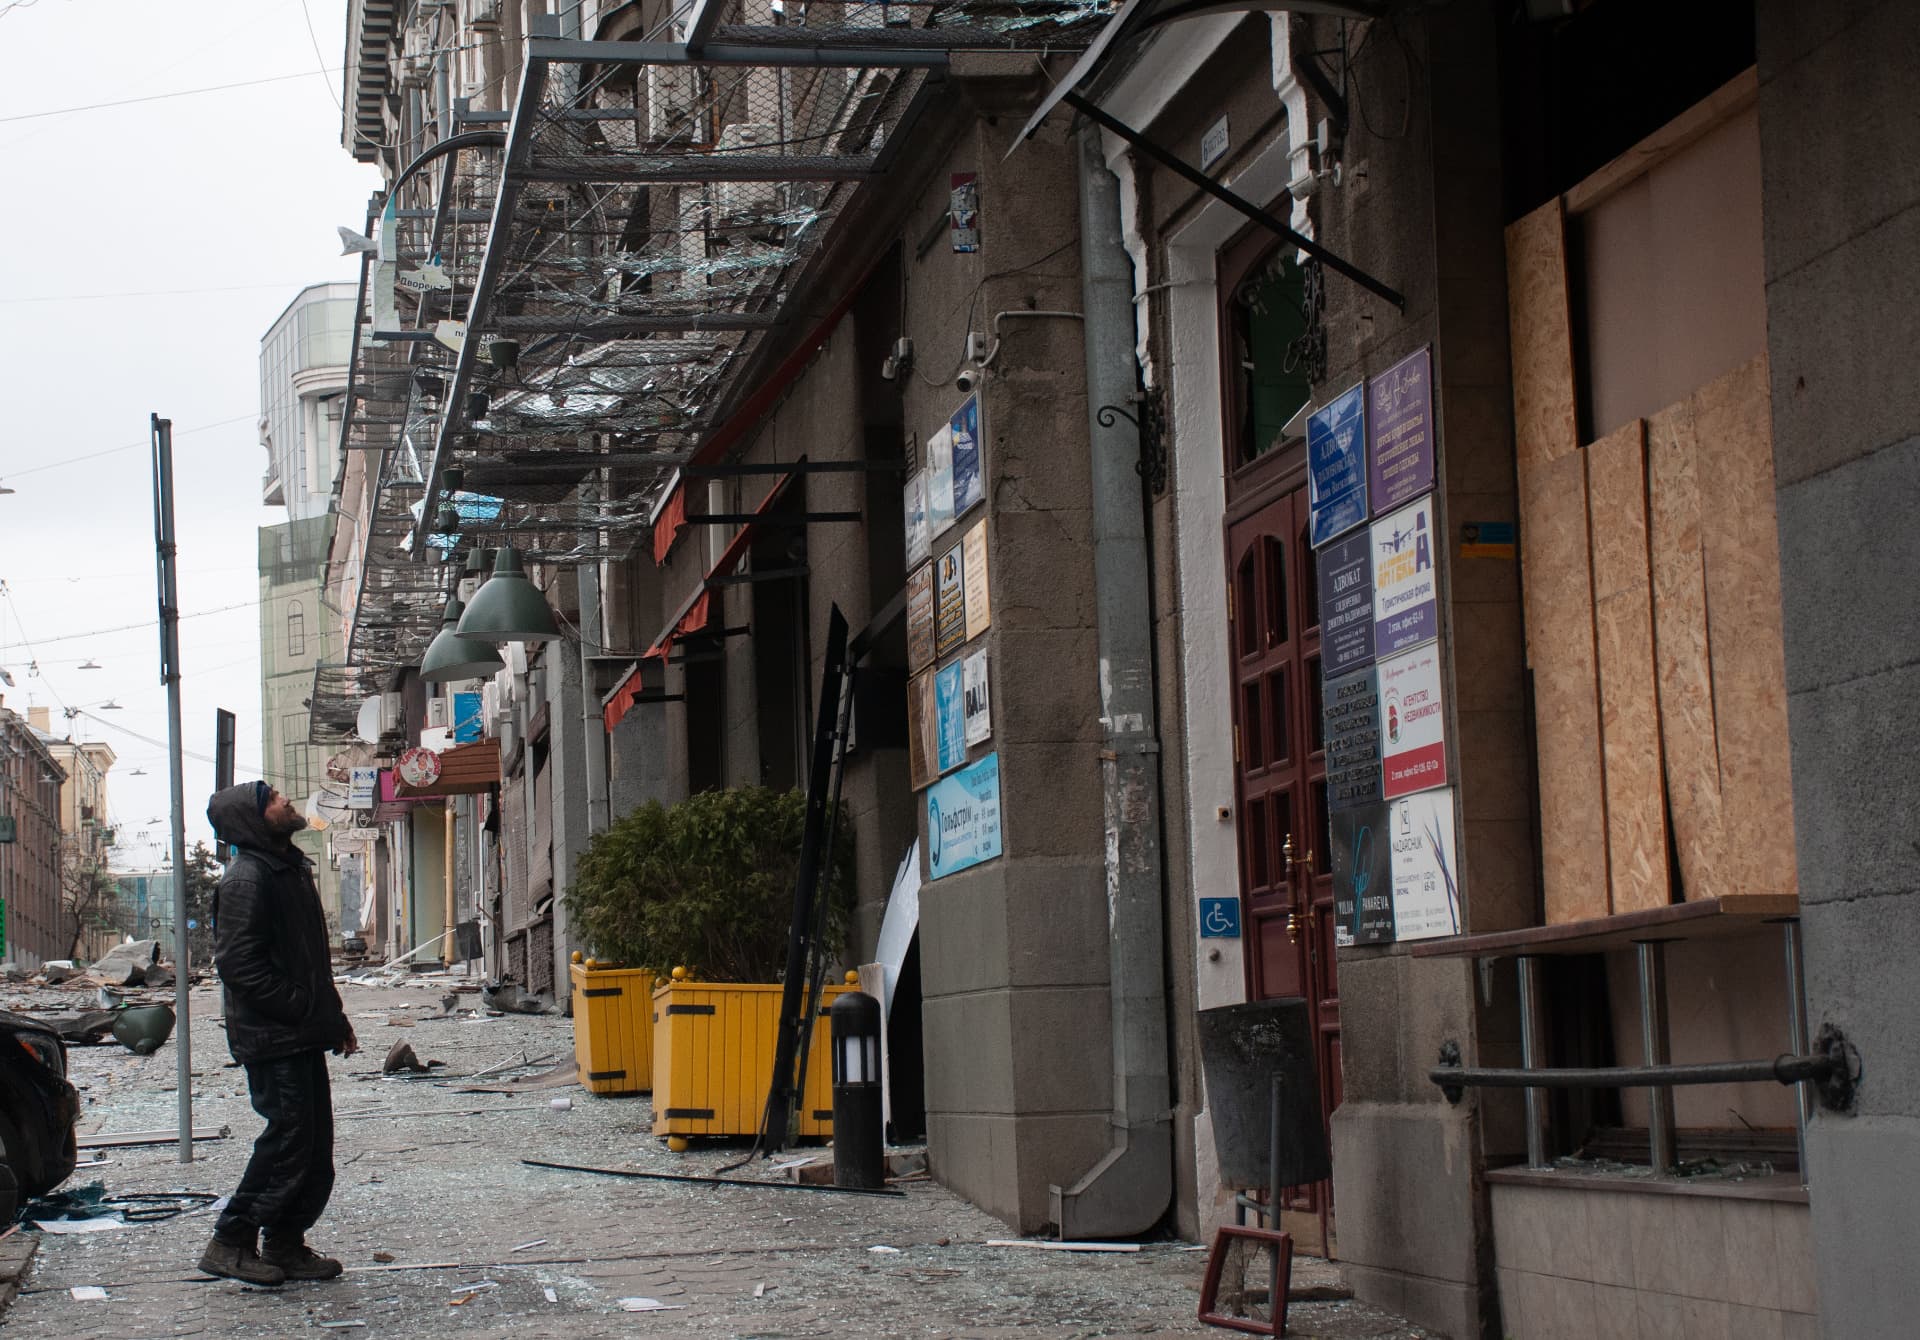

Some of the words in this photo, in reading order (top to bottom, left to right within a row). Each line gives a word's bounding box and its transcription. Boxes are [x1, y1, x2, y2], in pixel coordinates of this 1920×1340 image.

[1333, 567, 1361, 593] АДВОКАТ
[965, 681, 987, 720] BALI
[1403, 688, 1429, 707] АГЕНТСТВО
[1404, 701, 1441, 724] НЕДВИЖИМОСТИ
[941, 800, 972, 833] Гольфстрім
[1393, 836, 1423, 853] NAZARCHUK
